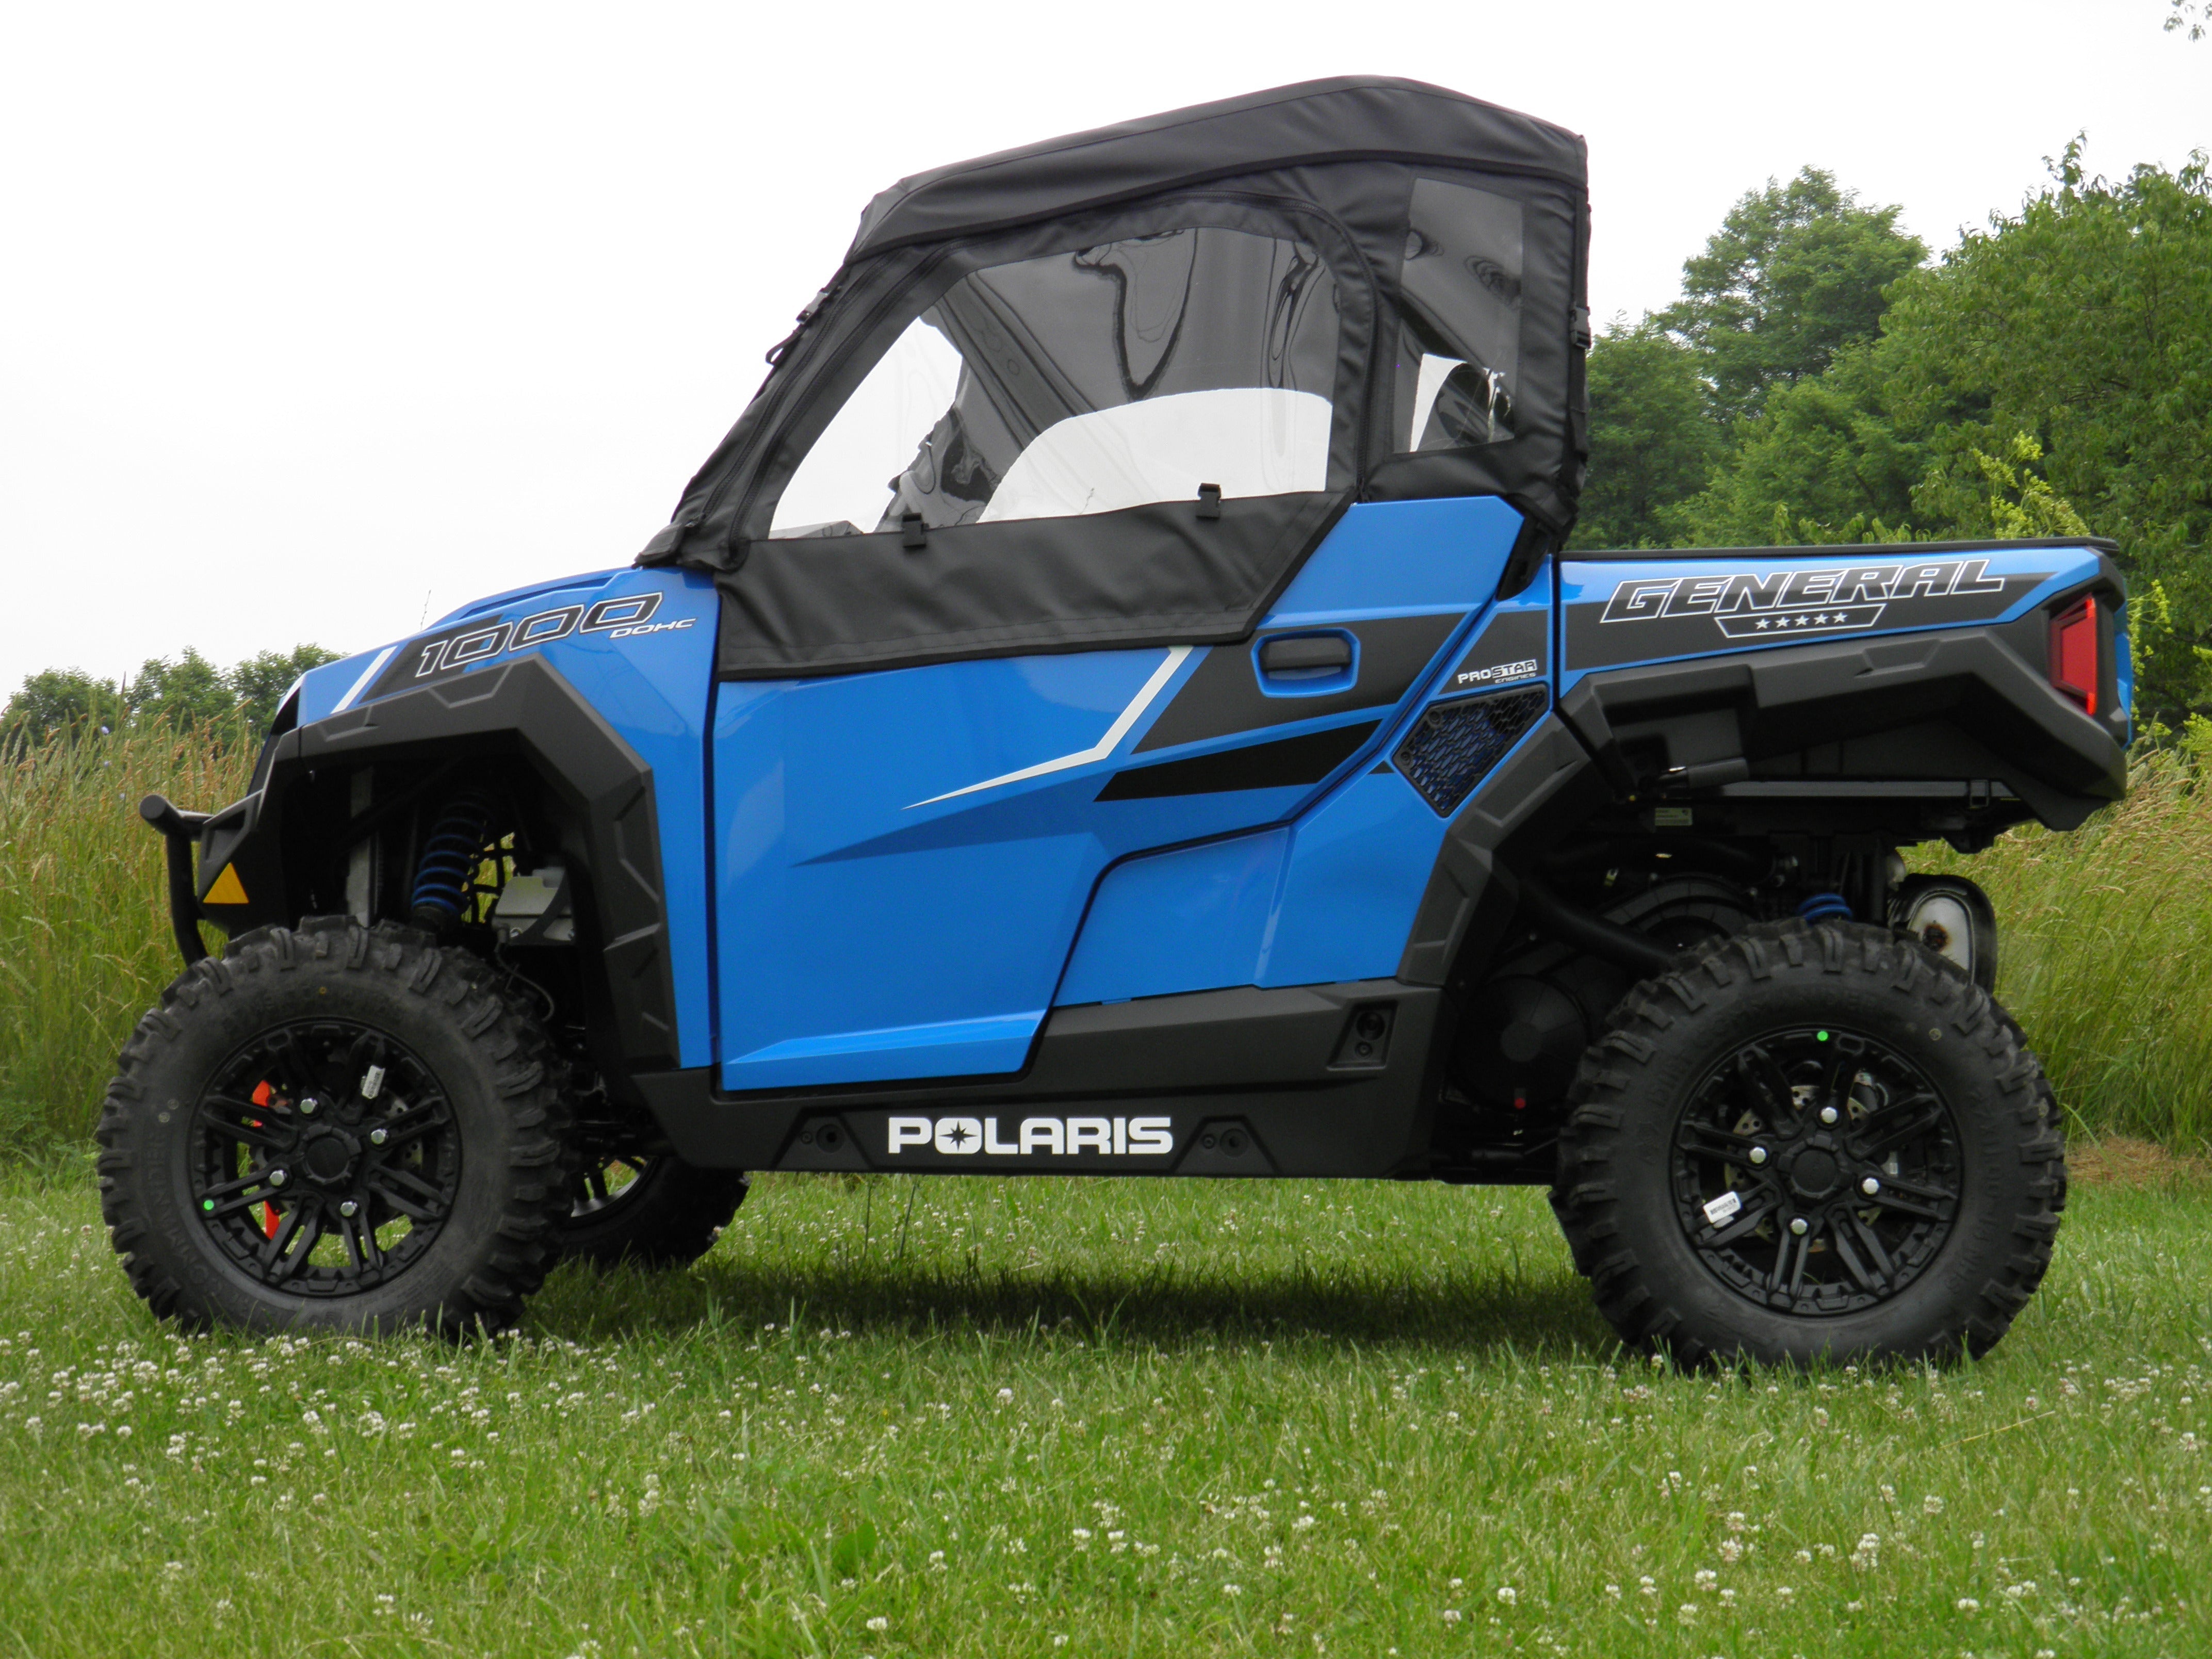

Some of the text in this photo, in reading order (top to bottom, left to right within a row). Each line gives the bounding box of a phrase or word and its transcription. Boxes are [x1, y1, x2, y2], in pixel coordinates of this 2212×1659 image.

[1600, 559, 2005, 623] GENERAL
[415, 591, 663, 678] 1000
[610, 619, 696, 639] DOHC
[1457, 659, 1538, 684] PROSTAR
[888, 1117, 1173, 1154] POLARIS
